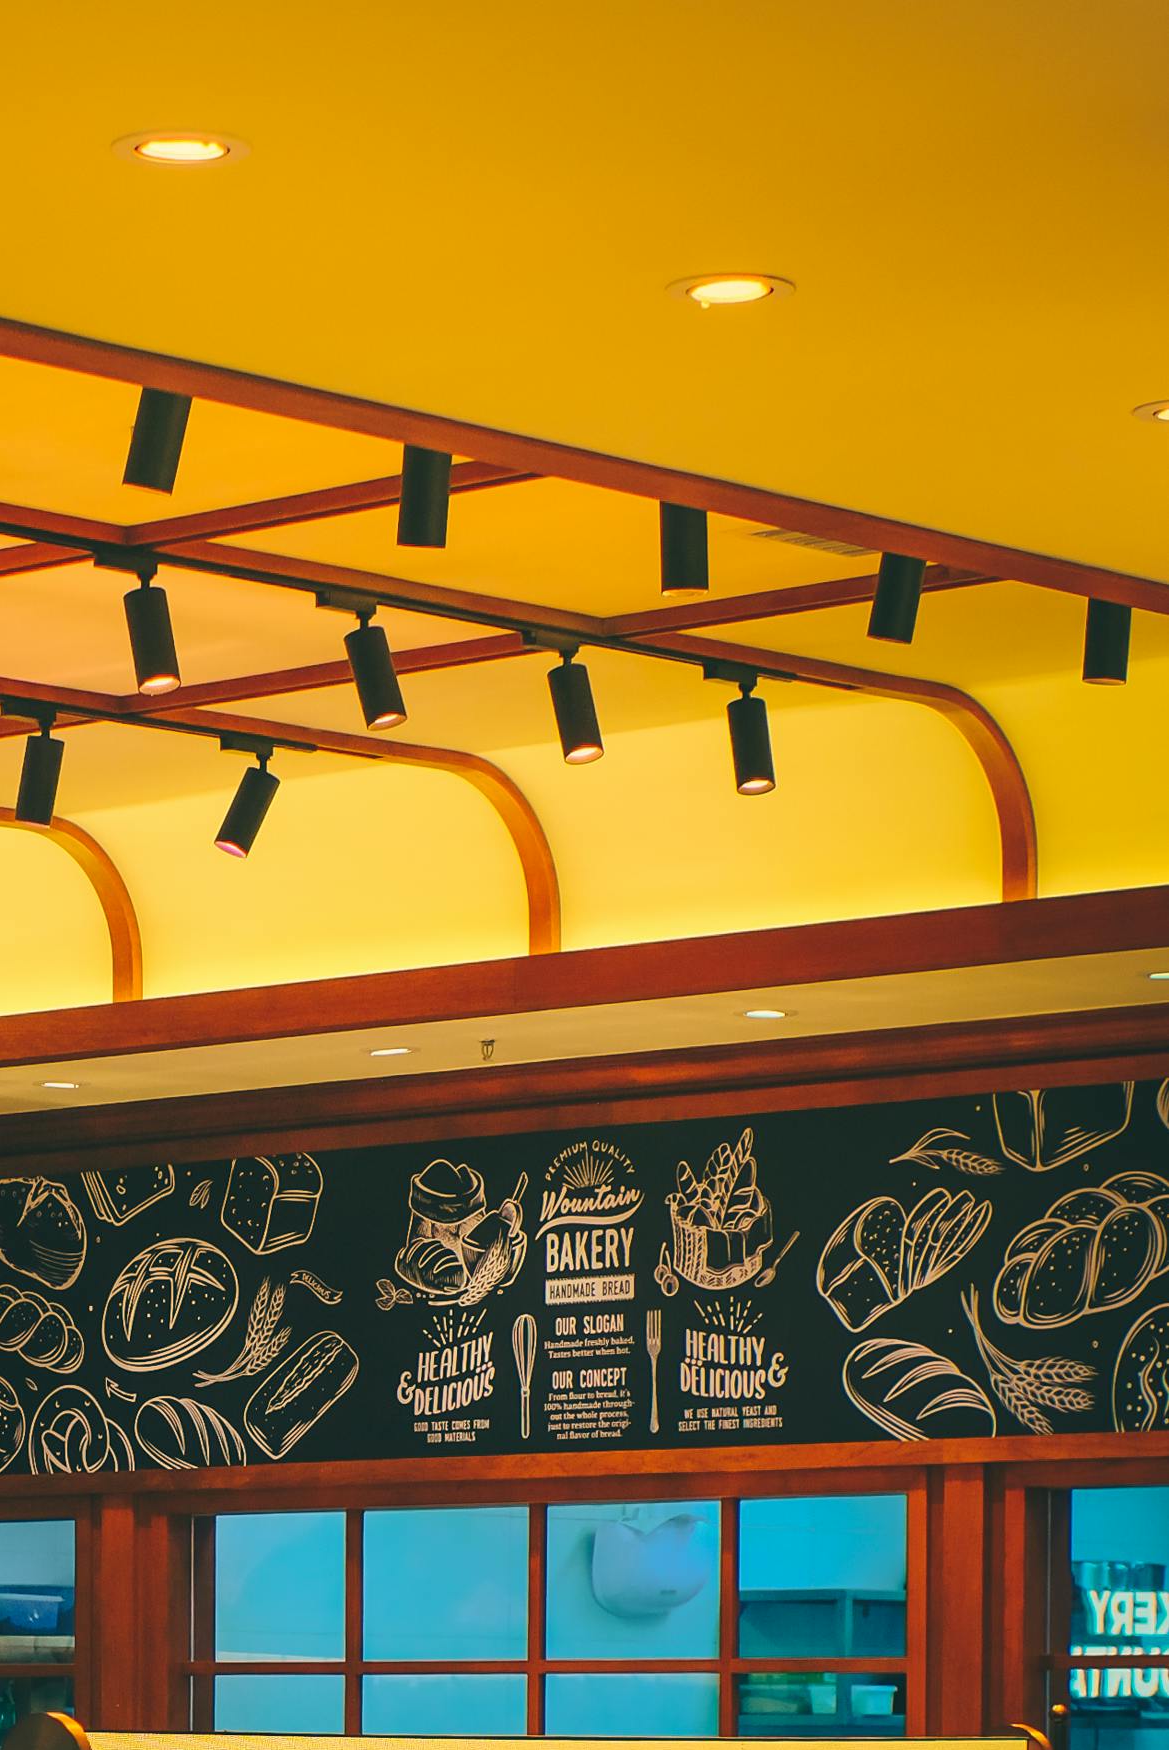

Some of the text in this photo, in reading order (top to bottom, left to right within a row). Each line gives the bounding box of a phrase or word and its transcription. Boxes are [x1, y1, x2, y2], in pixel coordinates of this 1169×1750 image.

[545, 1139, 636, 1181] PREMIUM QUALITY
[539, 1184, 641, 1222] Wountain
[546, 1227, 635, 1273] BAKERY
[549, 1279, 631, 1300] HANDMADE BREAD
[555, 1313, 624, 1336] OUR SLOGAN
[544, 1339, 584, 1349] Handmade
[584, 1337, 609, 1347] freshly
[417, 1331, 494, 1383] HEALTHY
[548, 1349, 571, 1359] Tastes
[572, 1348, 594, 1357] better
[595, 1347, 615, 1356] when
[685, 1328, 789, 1388] HEALTHY &
[552, 1367, 627, 1390] OUR CONCEPT
[680, 1362, 766, 1400] DELICIOUS
[397, 1366, 496, 1416] & DELICIOUS
[548, 1393, 568, 1402] From
[569, 1391, 586, 1400] flour
[587, 1391, 595, 1399] to
[544, 1402, 562, 1411] 100%
[563, 1400, 601, 1410] handmade
[684, 1404, 777, 1419] WE USE NATURAL YEAST AND
[549, 1412, 562, 1421] out
[563, 1411, 575, 1420] the
[576, 1410, 598, 1419] whole
[414, 1418, 490, 1432] GOOD TASTE COMES FROM
[548, 1422, 562, 1432] just
[562, 1421, 570, 1430] to
[571, 1421, 597, 1429] restore
[598, 1420, 610, 1429] the
[678, 1417, 783, 1432] SELECT THE FINEST INGREDIENTS
[444, 1431, 476, 1442] MATERIALS
[557, 1431, 568, 1440] nal
[569, 1430, 590, 1440] flavor
[591, 1429, 599, 1438] of
